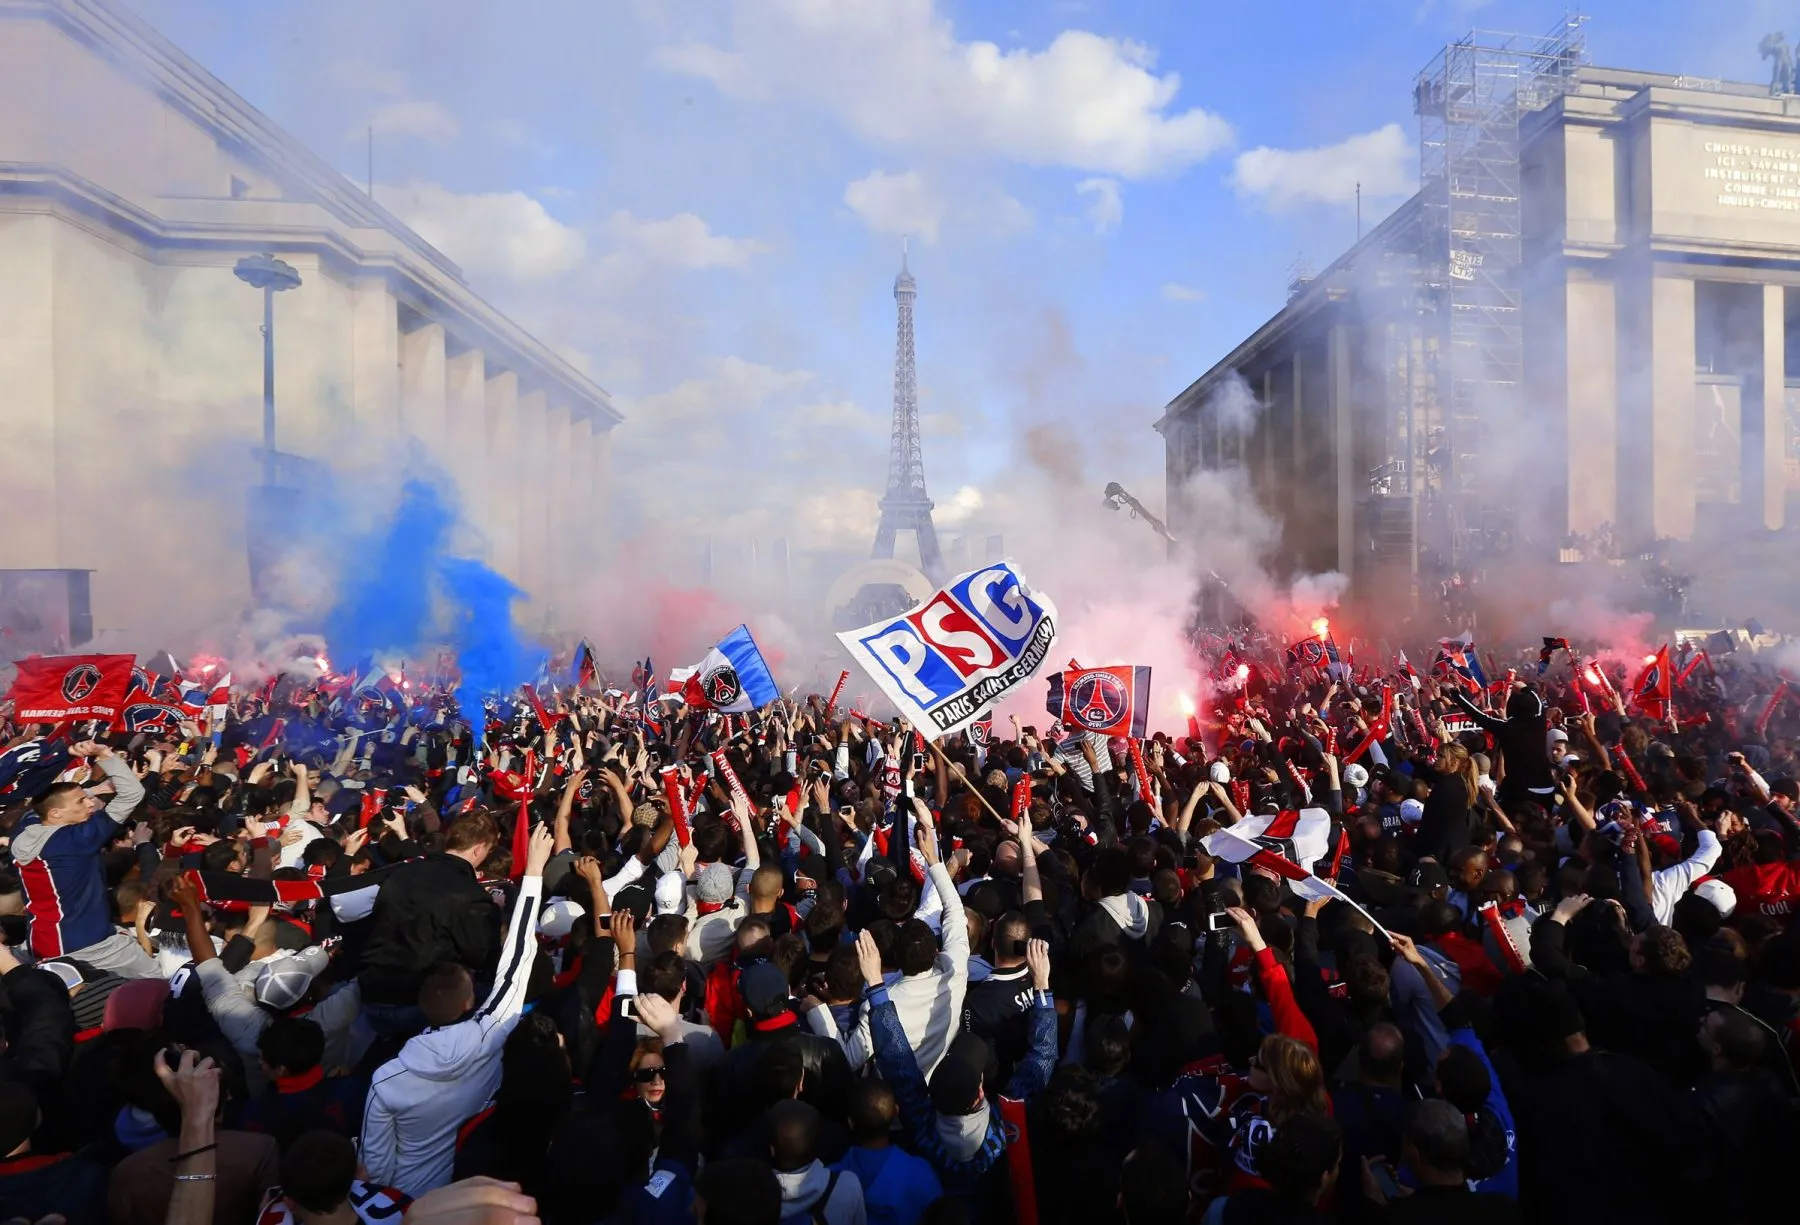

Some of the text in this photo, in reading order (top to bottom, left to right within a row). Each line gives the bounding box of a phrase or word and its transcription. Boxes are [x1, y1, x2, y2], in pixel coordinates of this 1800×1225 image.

[1704, 142, 1751, 155] CHOSES
[1716, 156, 1800, 172] ICI SAVAMM
[866, 569, 1033, 706] PSG
[931, 695, 974, 730] PARIS
